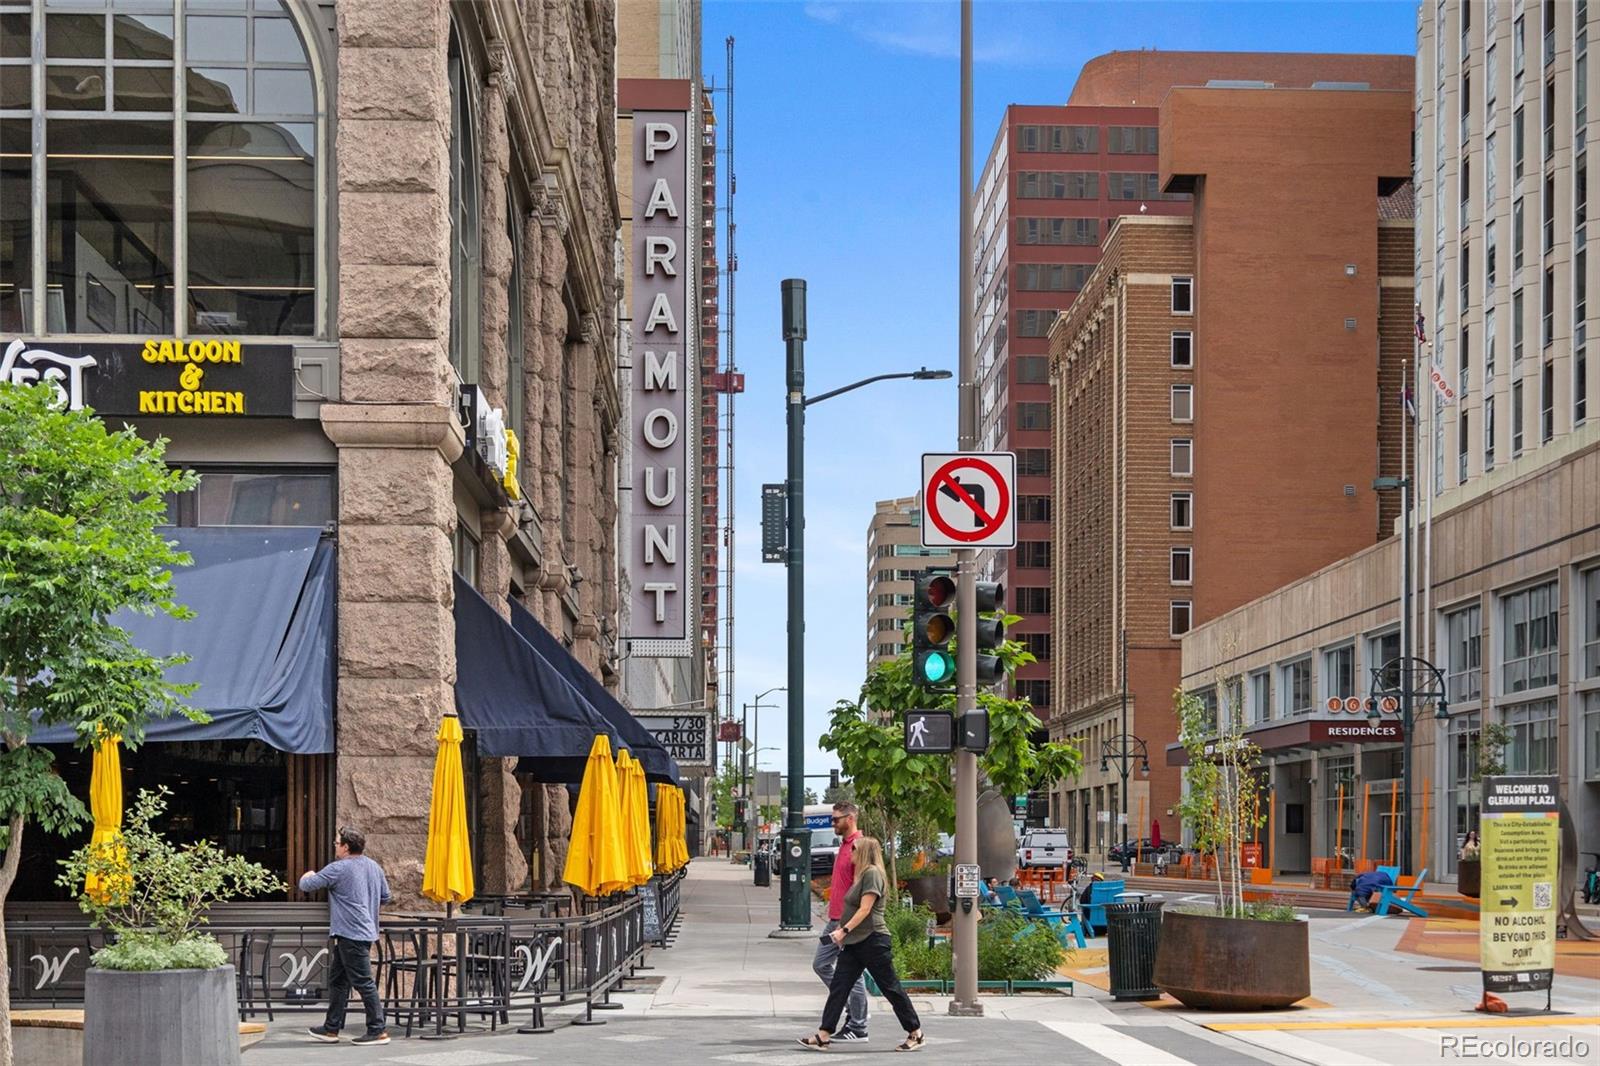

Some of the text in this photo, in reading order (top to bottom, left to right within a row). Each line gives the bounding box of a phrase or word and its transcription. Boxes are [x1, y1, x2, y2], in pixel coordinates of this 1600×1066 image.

[142, 340, 242, 363] SALOON
[0, 338, 98, 411] EST
[179, 363, 204, 392] &
[643, 123, 679, 624] PARAMOUNT
[139, 391, 244, 414] KITCHEN
[673, 718, 703, 729] 5/30
[1328, 727, 1396, 736] RESIDENCES
[655, 731, 703, 744] CARLOS
[1495, 785, 1549, 794] WELCOME TO
[1488, 796, 1556, 805] GLENARM PLAZA
[806, 816, 830, 826] Budget
[1494, 917, 1509, 926] NO
[1493, 931, 1546, 942] BEYOND THIS
[1512, 948, 1532, 958] POINT
